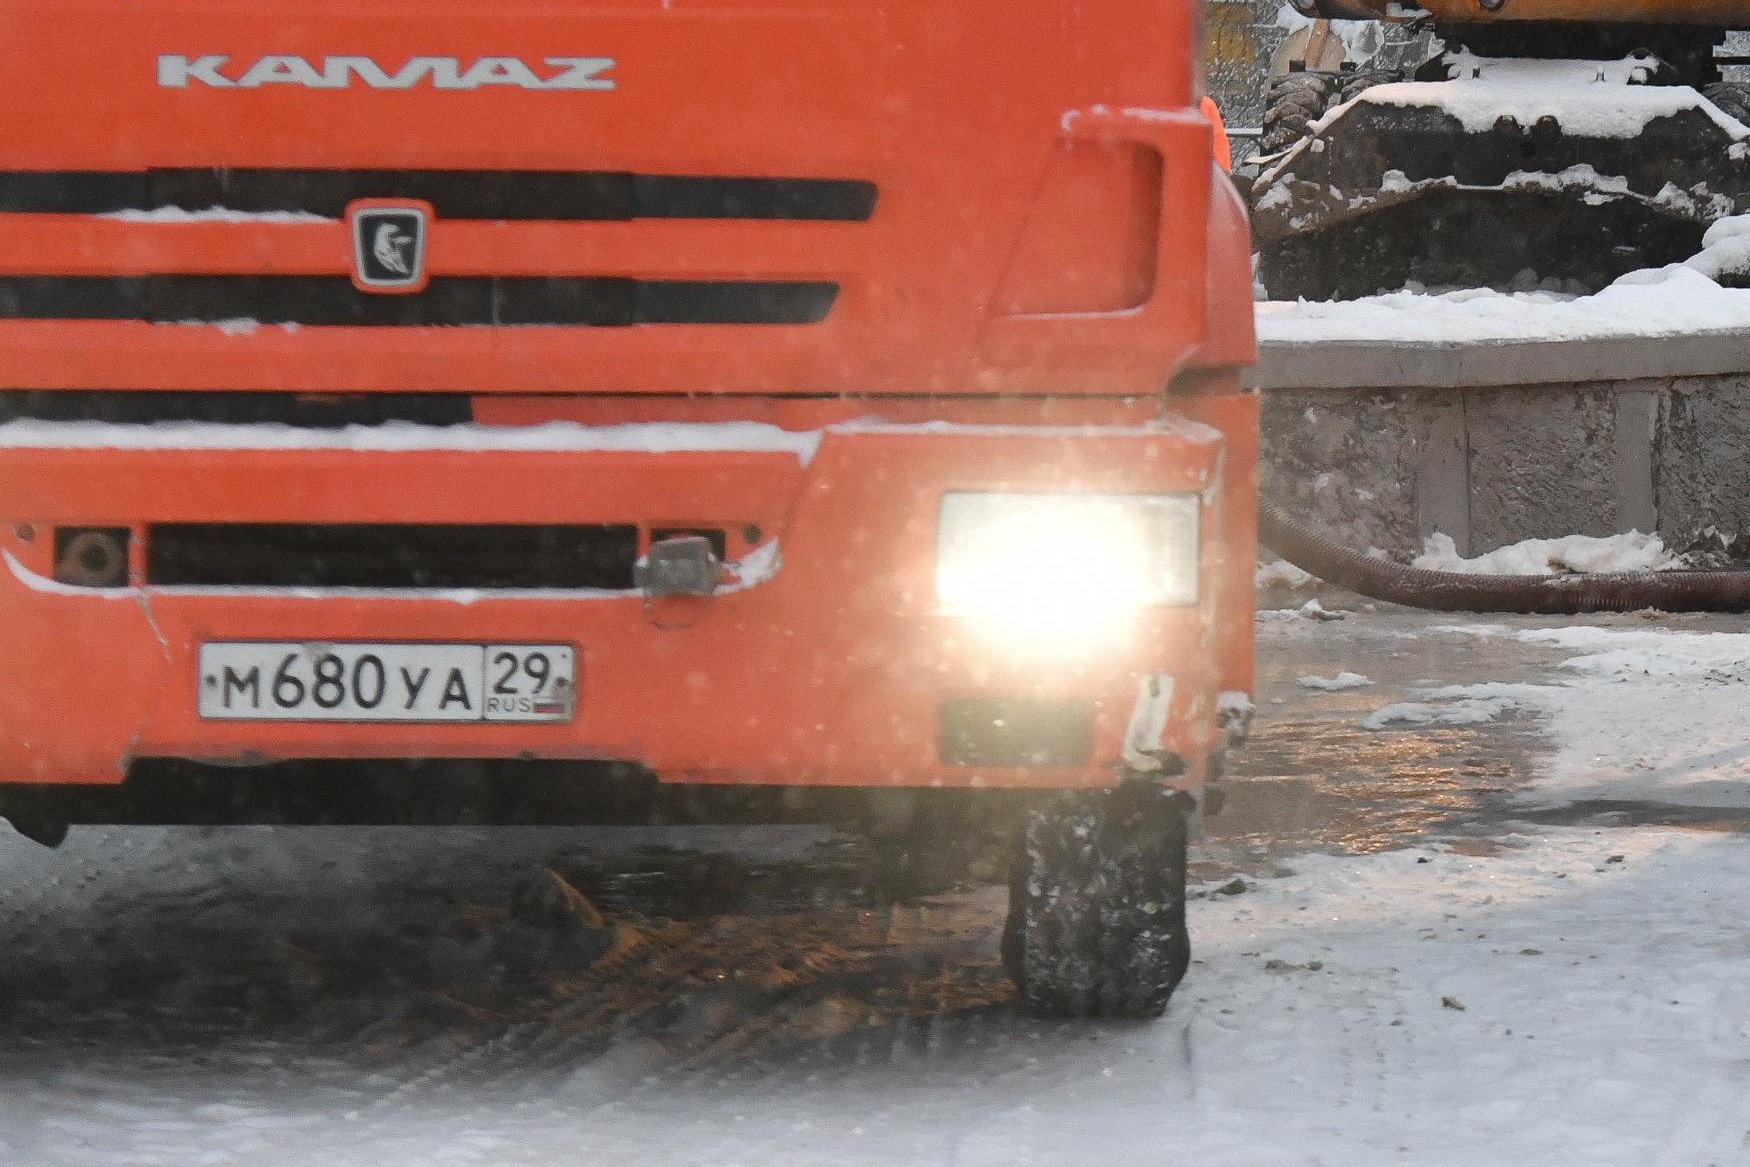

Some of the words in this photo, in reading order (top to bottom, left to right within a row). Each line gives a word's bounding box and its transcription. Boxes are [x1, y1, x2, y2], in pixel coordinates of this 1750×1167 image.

[156, 54, 616, 90] KAMAZ
[222, 653, 472, 710] М680УА
[493, 651, 551, 695] 29
[488, 697, 531, 713] RUS
